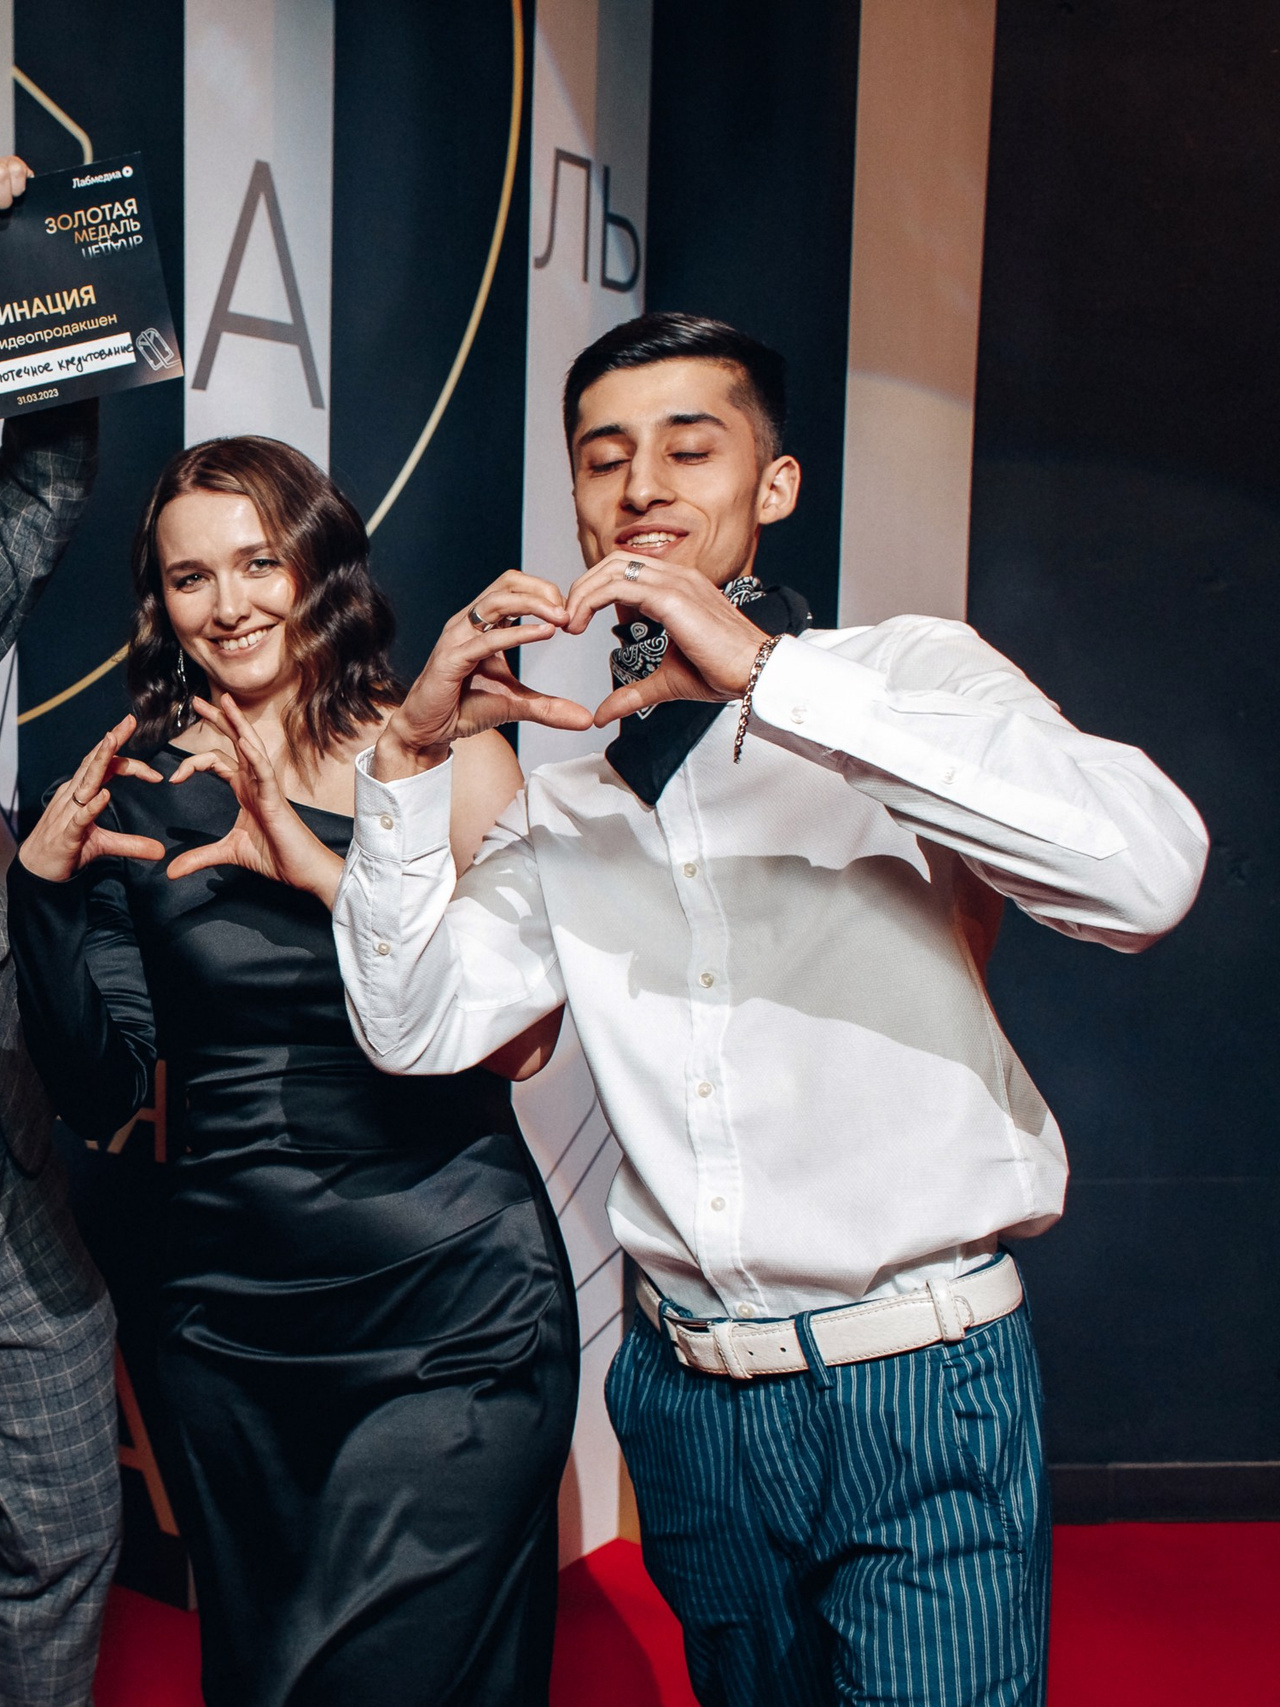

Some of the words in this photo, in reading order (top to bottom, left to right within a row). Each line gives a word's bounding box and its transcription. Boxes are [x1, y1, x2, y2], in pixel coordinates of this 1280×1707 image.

[72, 170, 123, 190] Лабмедиа
[44, 198, 138, 235] ЗОЛОТАЯ
[74, 218, 141, 245] МЕДАЛЬ
[16, 388, 60, 406] 31.03.2023
